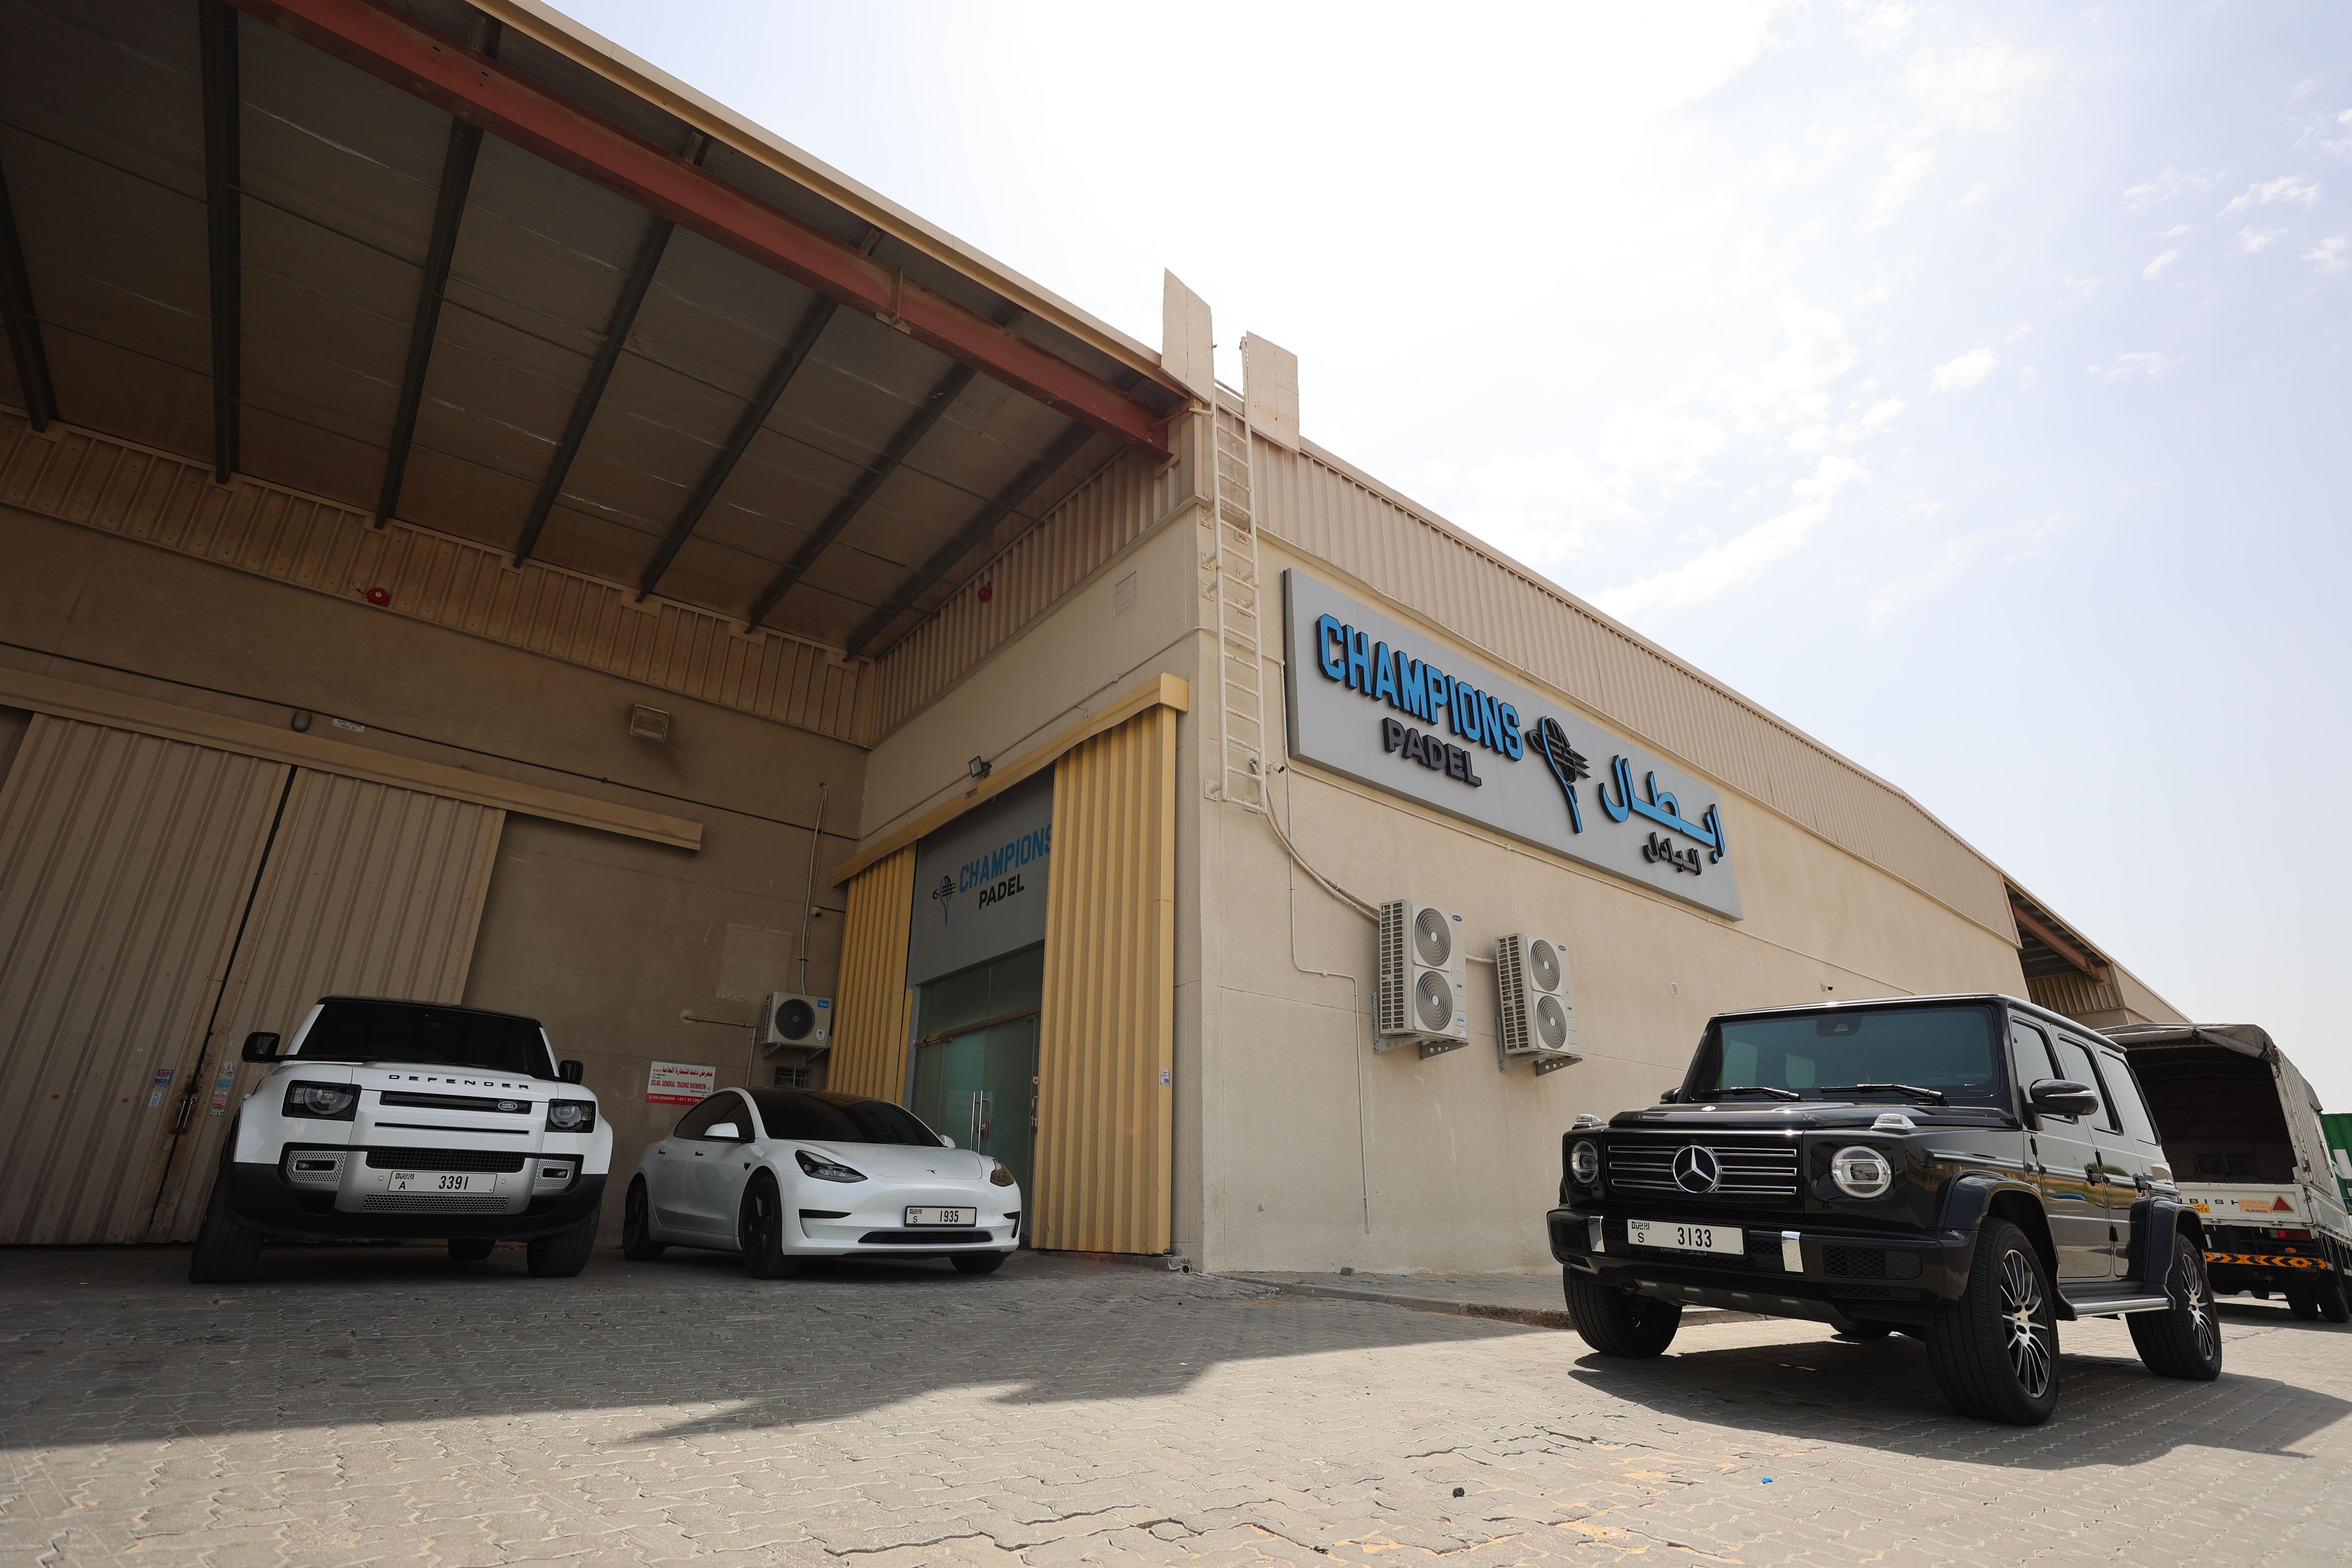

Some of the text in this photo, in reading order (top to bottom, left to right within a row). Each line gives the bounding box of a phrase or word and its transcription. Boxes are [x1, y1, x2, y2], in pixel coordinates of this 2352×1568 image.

[1316, 613, 1524, 761] CHAMPIONS
[1382, 717, 1482, 787] PADEL
[979, 873, 1024, 910] PADEL
[675, 1067, 689, 1075] للتجارة
[699, 1069, 713, 1078] معرض
[389, 1075, 529, 1090] DEFENDER
[398, 1181, 405, 1190] A
[439, 1176, 469, 1190] 3391
[940, 1210, 959, 1222] 1935
[1638, 1232, 1645, 1243] S
[1678, 1227, 1712, 1248] 3133
